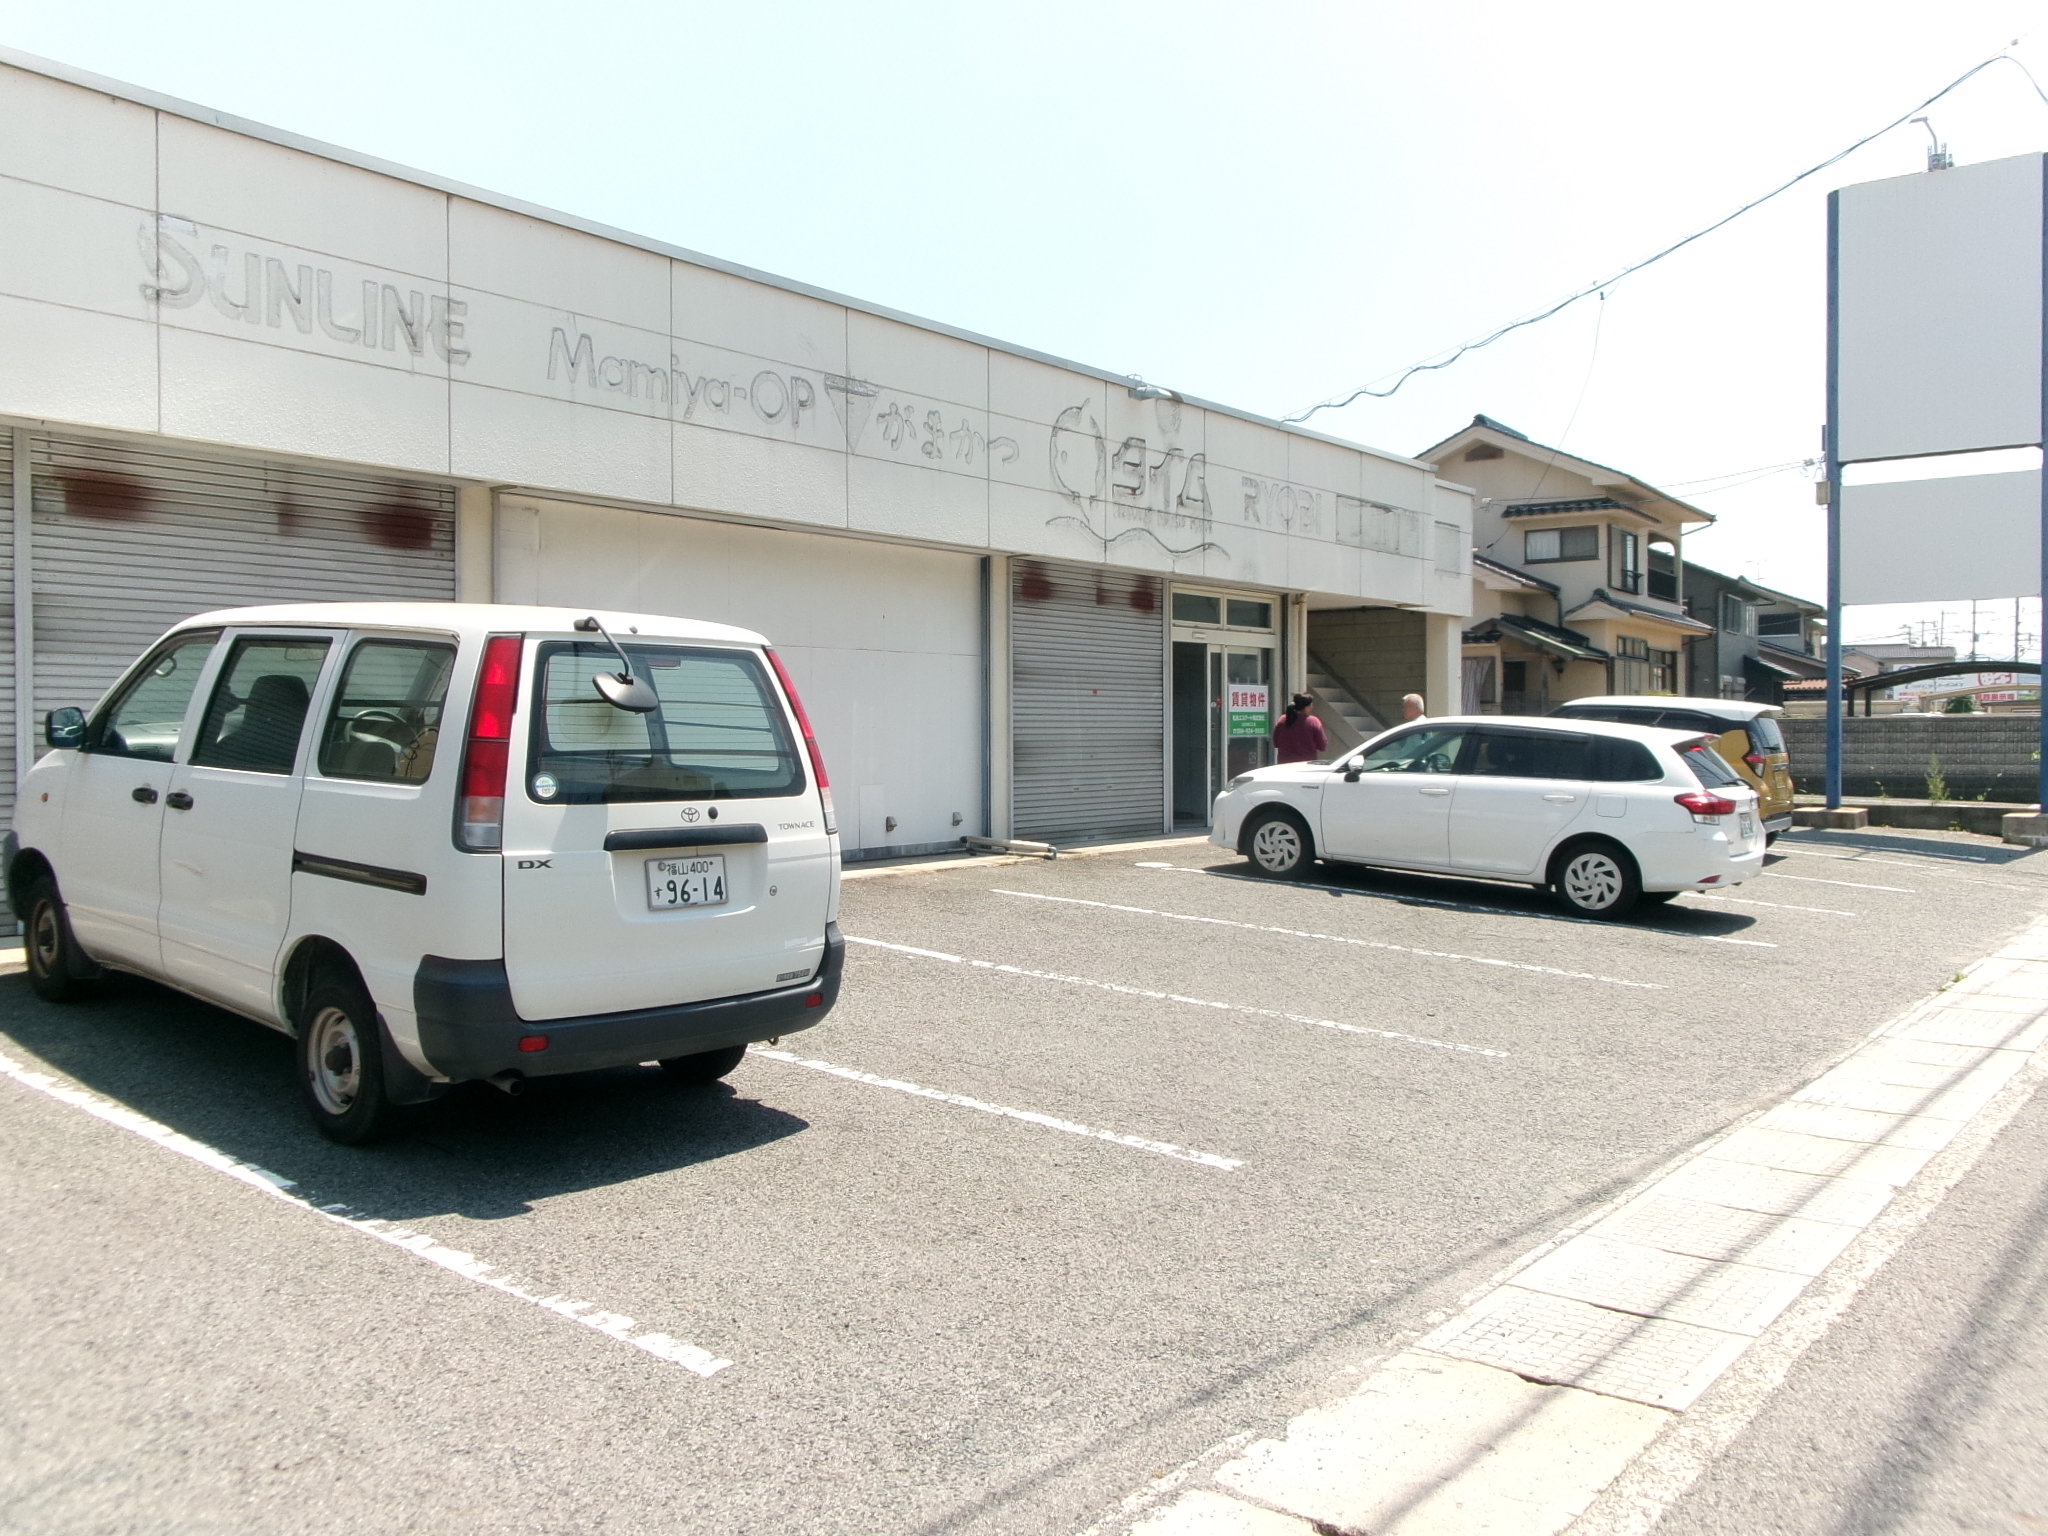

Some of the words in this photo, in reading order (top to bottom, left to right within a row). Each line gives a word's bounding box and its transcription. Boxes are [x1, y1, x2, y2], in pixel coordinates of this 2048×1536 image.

[138, 213, 471, 366] SUNLINE
[547, 327, 815, 429] Mamiya-OP
[1232, 692, 1265, 707] 賃貸物件
[517, 859, 553, 870] DX
[666, 875, 724, 904] 96-14
